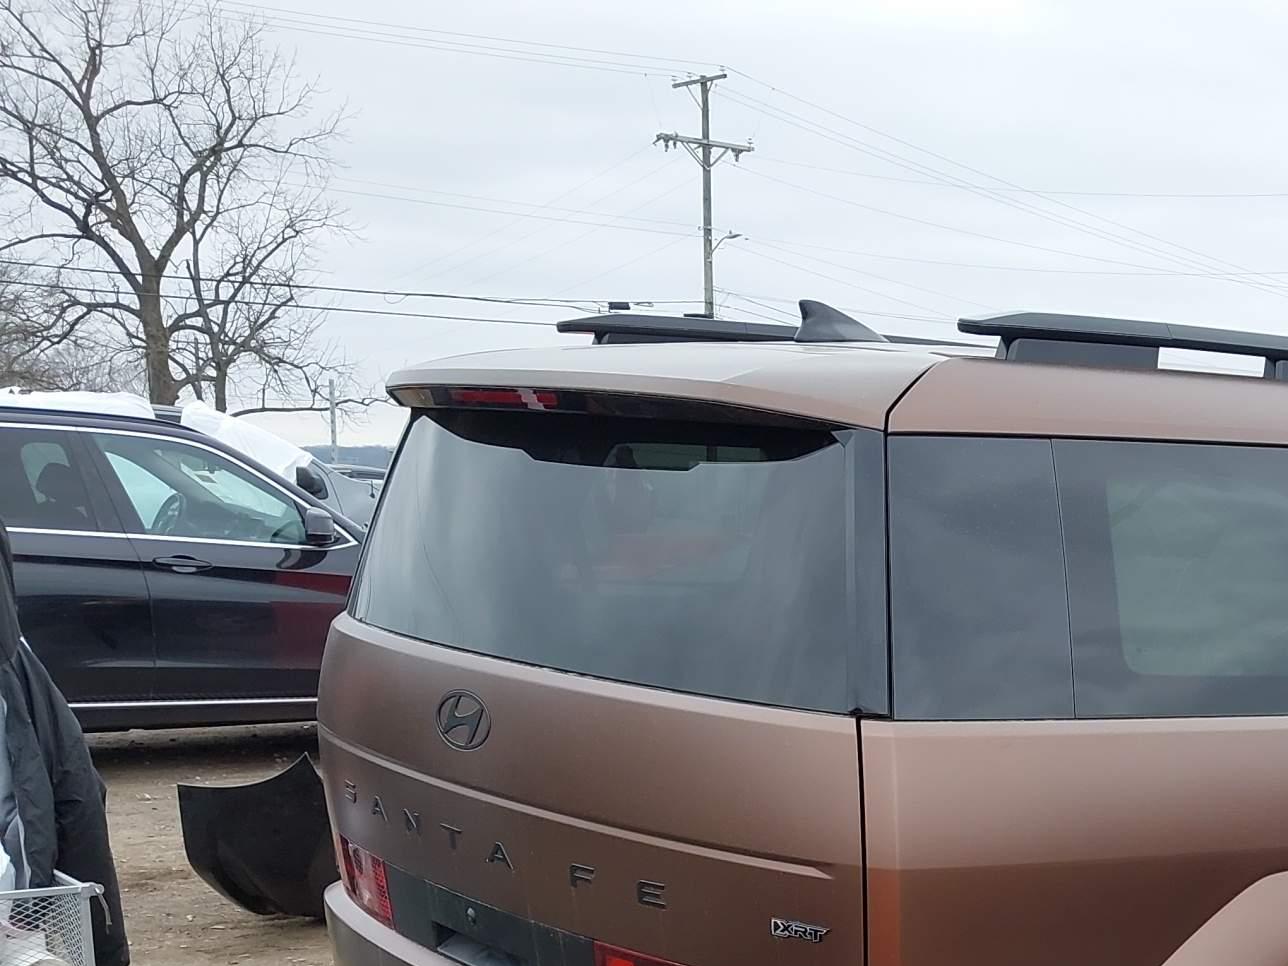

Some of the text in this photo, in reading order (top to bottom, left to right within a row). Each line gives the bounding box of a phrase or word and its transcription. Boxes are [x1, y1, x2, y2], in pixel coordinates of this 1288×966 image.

[344, 779, 667, 910] SANTA FE
[771, 917, 830, 942] XRT
